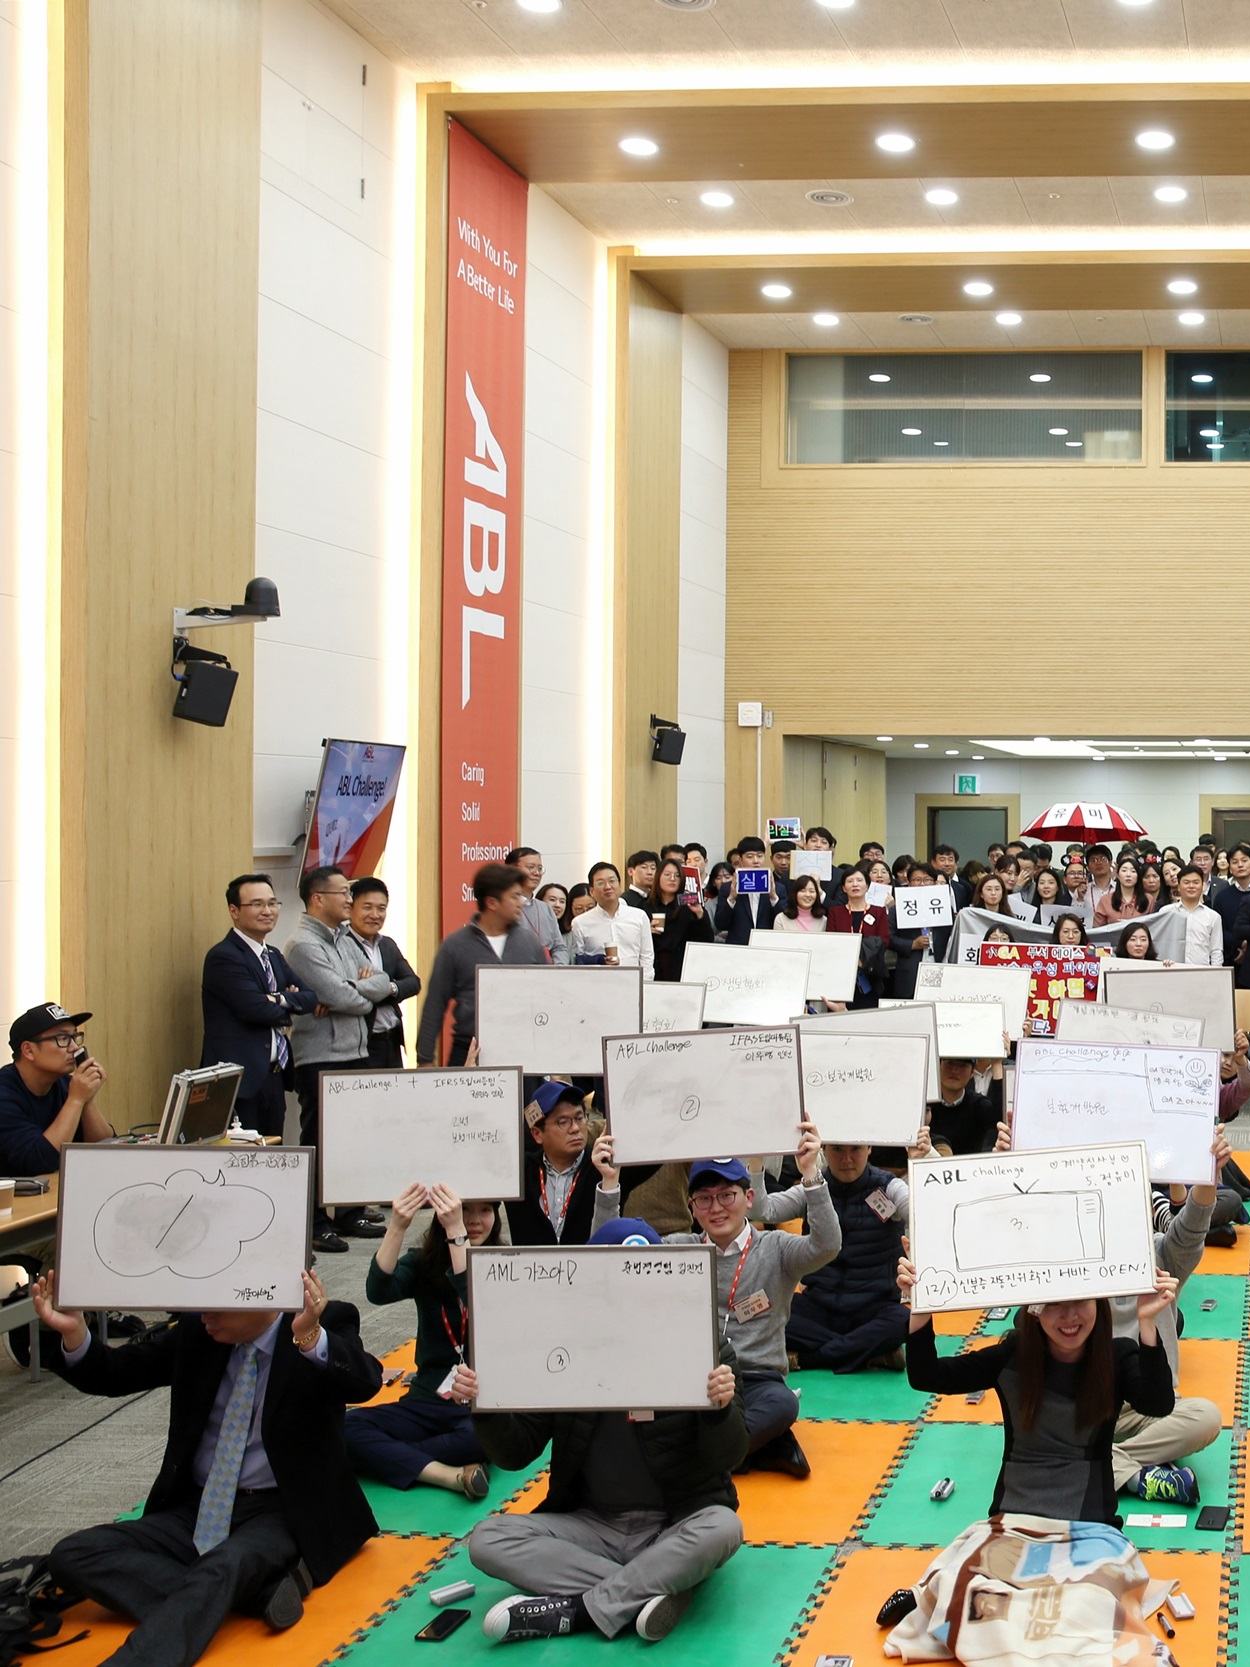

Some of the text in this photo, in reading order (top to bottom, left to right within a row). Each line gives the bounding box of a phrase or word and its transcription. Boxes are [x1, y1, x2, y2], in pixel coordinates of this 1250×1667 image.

[458, 217, 518, 278] With You For
[457, 258, 514, 314] A Better Life
[462, 370, 506, 710] ABL
[363, 746, 374, 759] ABL
[461, 761, 485, 786] Caring
[336, 776, 388, 802] ABL Challenge!
[461, 802, 480, 821] Solid
[1027, 946, 1048, 959] 부서
[1051, 947, 1085, 959] 에이스
[1062, 962, 1099, 976] 파이팅
[1048, 978, 1085, 999] 하면
[616, 1039, 693, 1061] ABL Challenge
[328, 1081, 350, 1095] ABL
[923, 1166, 1025, 1187] ABL challenge
[1100, 1169, 1137, 1187] 정유미
[486, 1263, 520, 1282] AML
[959, 1275, 987, 1294] 신분증
[1099, 1262, 1147, 1278] OPEN!
